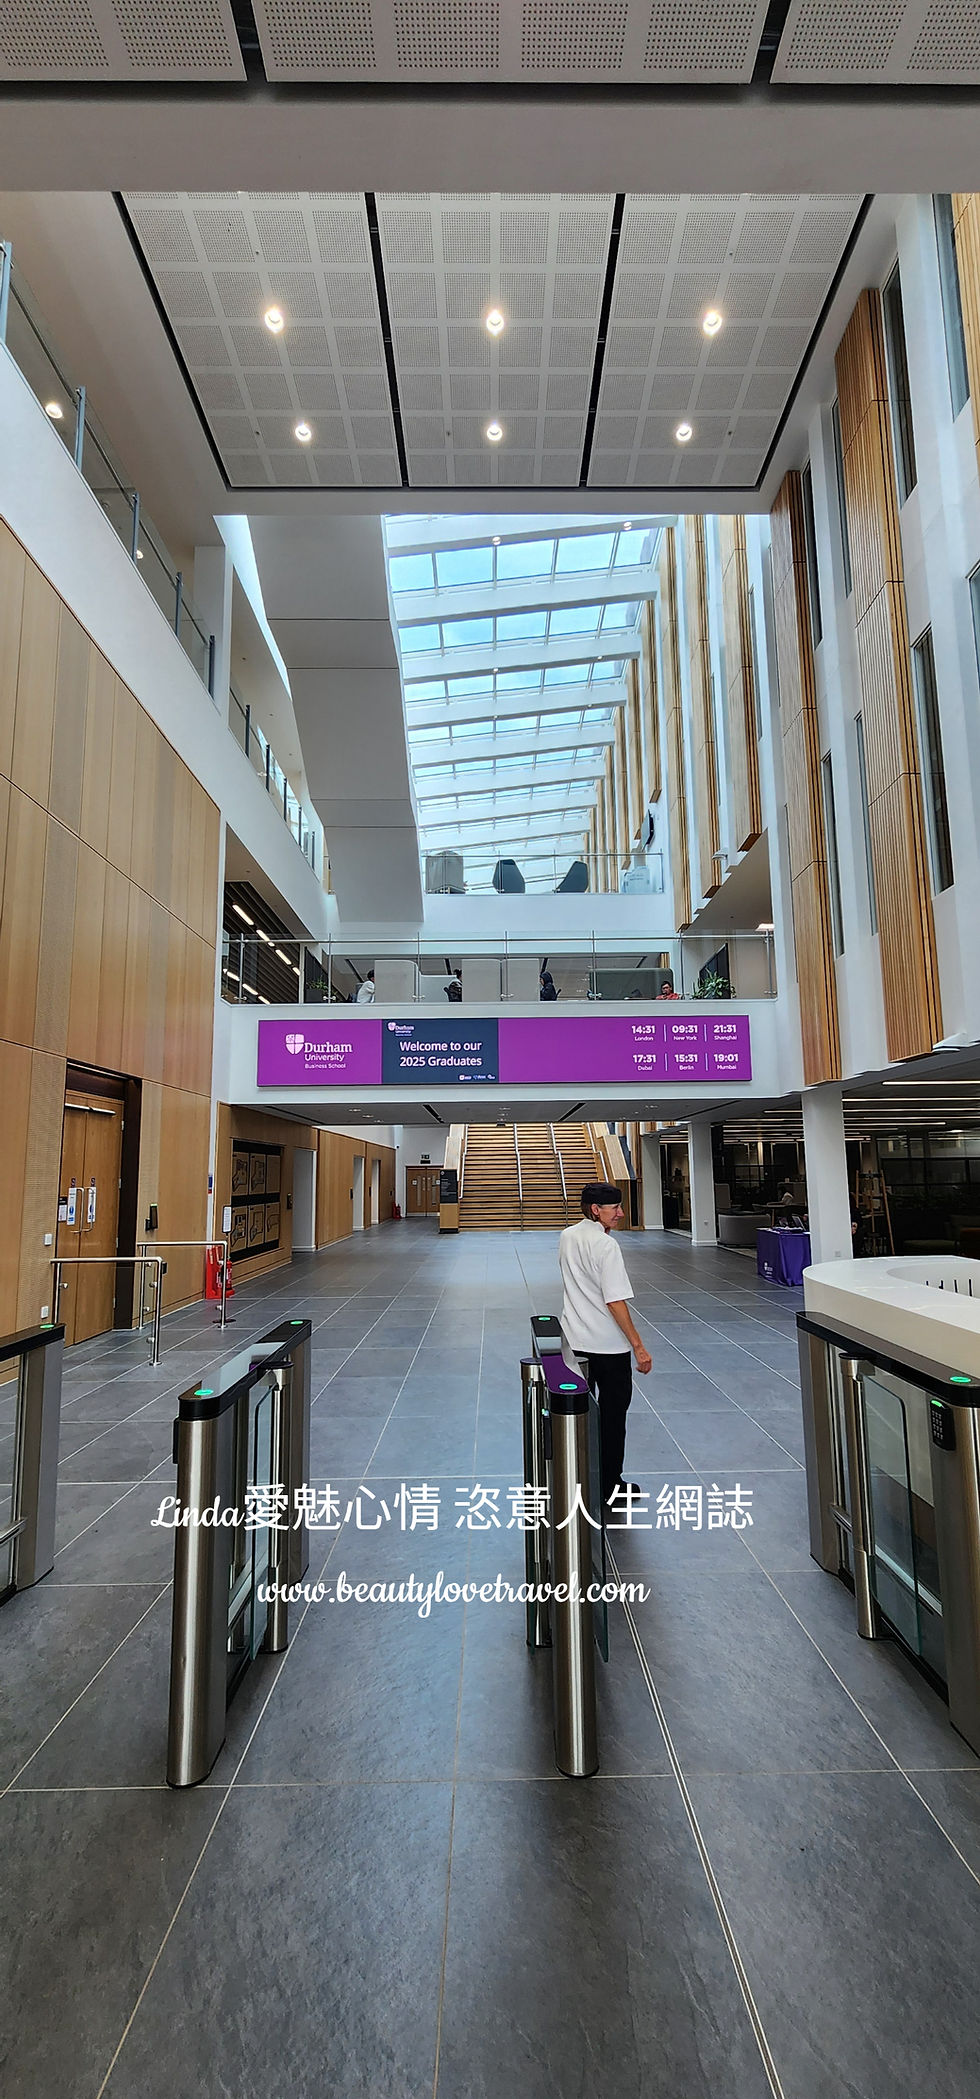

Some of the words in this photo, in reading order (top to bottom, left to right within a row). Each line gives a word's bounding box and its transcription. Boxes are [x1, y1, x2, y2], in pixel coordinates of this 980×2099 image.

[632, 1025, 655, 1034] 14:31
[672, 1025, 698, 1033] 09:31
[713, 1024, 737, 1033] 21:31
[304, 1042, 352, 1053] Durham
[400, 1041, 448, 1051] Welcome
[450, 1041, 461, 1051] to
[463, 1042, 482, 1051] our
[304, 1054, 345, 1062] University
[400, 1056, 426, 1067] 2025
[428, 1056, 482, 1067] Graduates
[633, 1054, 656, 1063] 17:31
[674, 1054, 698, 1063] 15:31
[713, 1054, 739, 1062] 19:01
